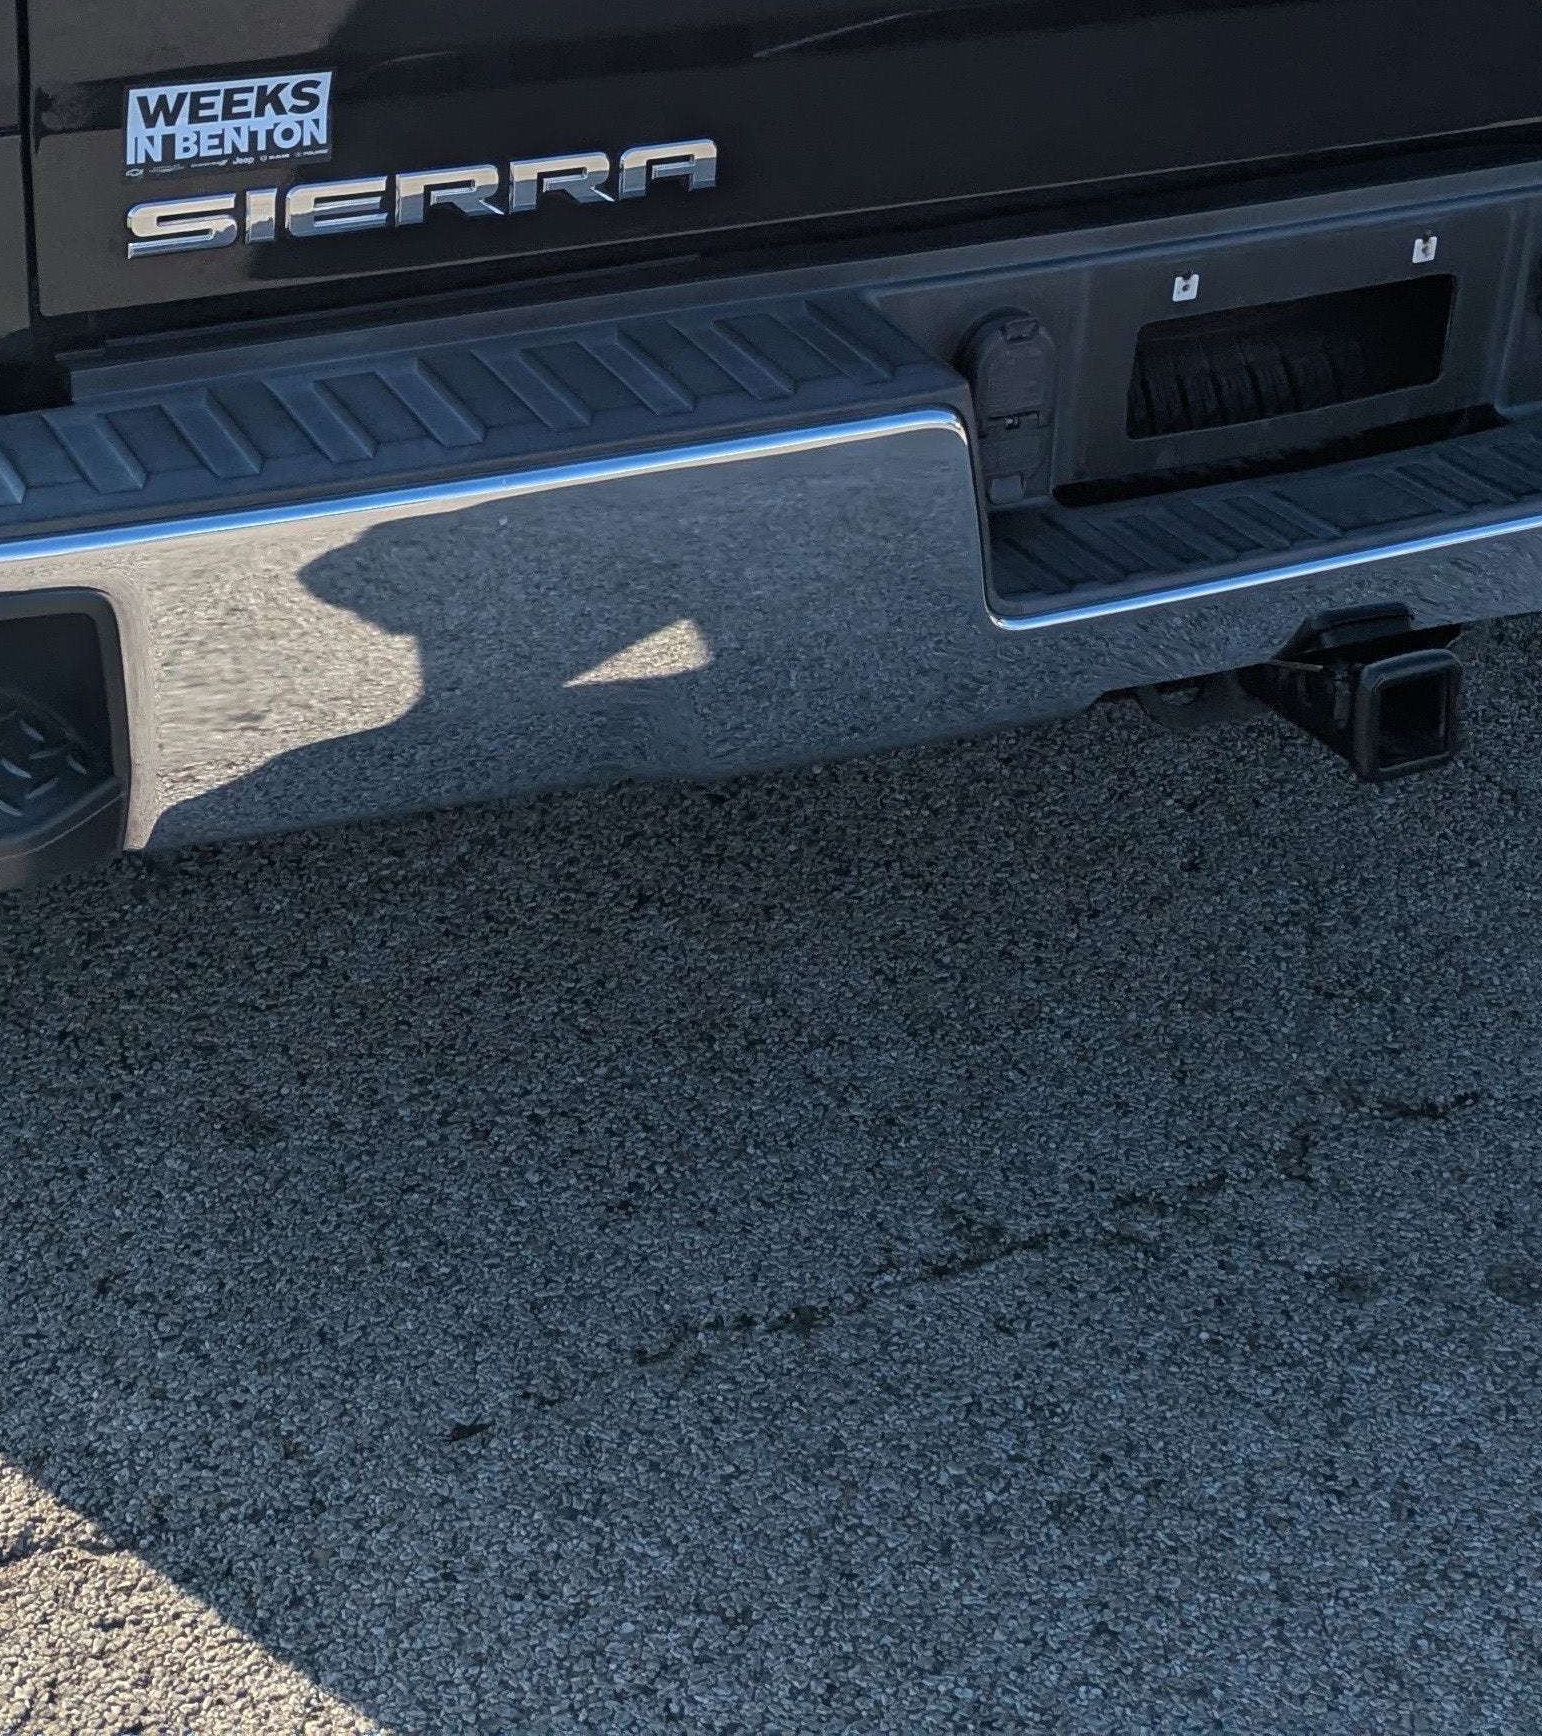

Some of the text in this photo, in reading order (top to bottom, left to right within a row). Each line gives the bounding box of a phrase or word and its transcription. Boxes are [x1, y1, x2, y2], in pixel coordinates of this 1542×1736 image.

[135, 79, 323, 130] WEEKS
[126, 118, 328, 165] IN BENTON
[232, 155, 256, 166] Jeep
[127, 137, 718, 260] SIERRA
